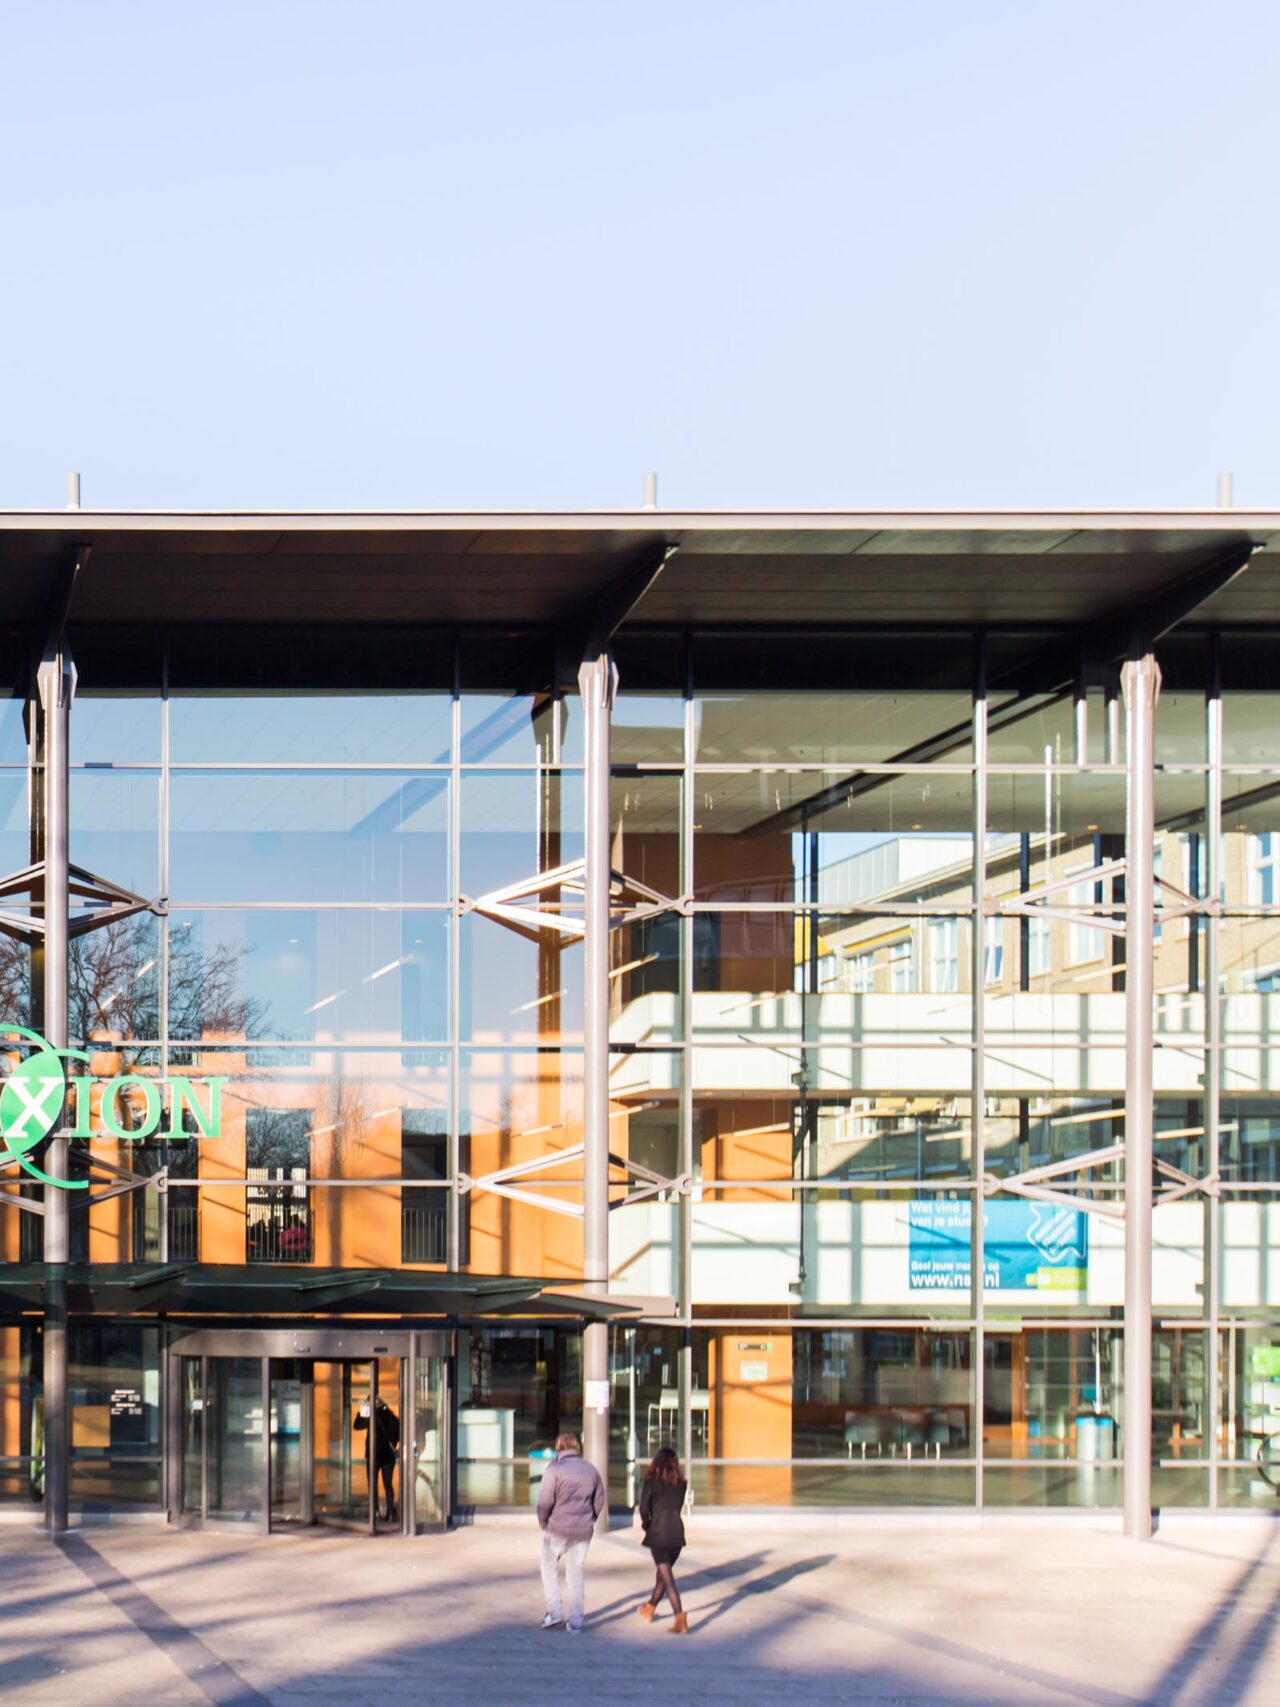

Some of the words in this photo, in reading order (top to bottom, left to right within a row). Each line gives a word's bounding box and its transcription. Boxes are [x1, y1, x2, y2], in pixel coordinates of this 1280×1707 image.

[911, 1201, 932, 1214] Wat
[935, 1200, 960, 1214] vind
[911, 1216, 931, 1228] van
